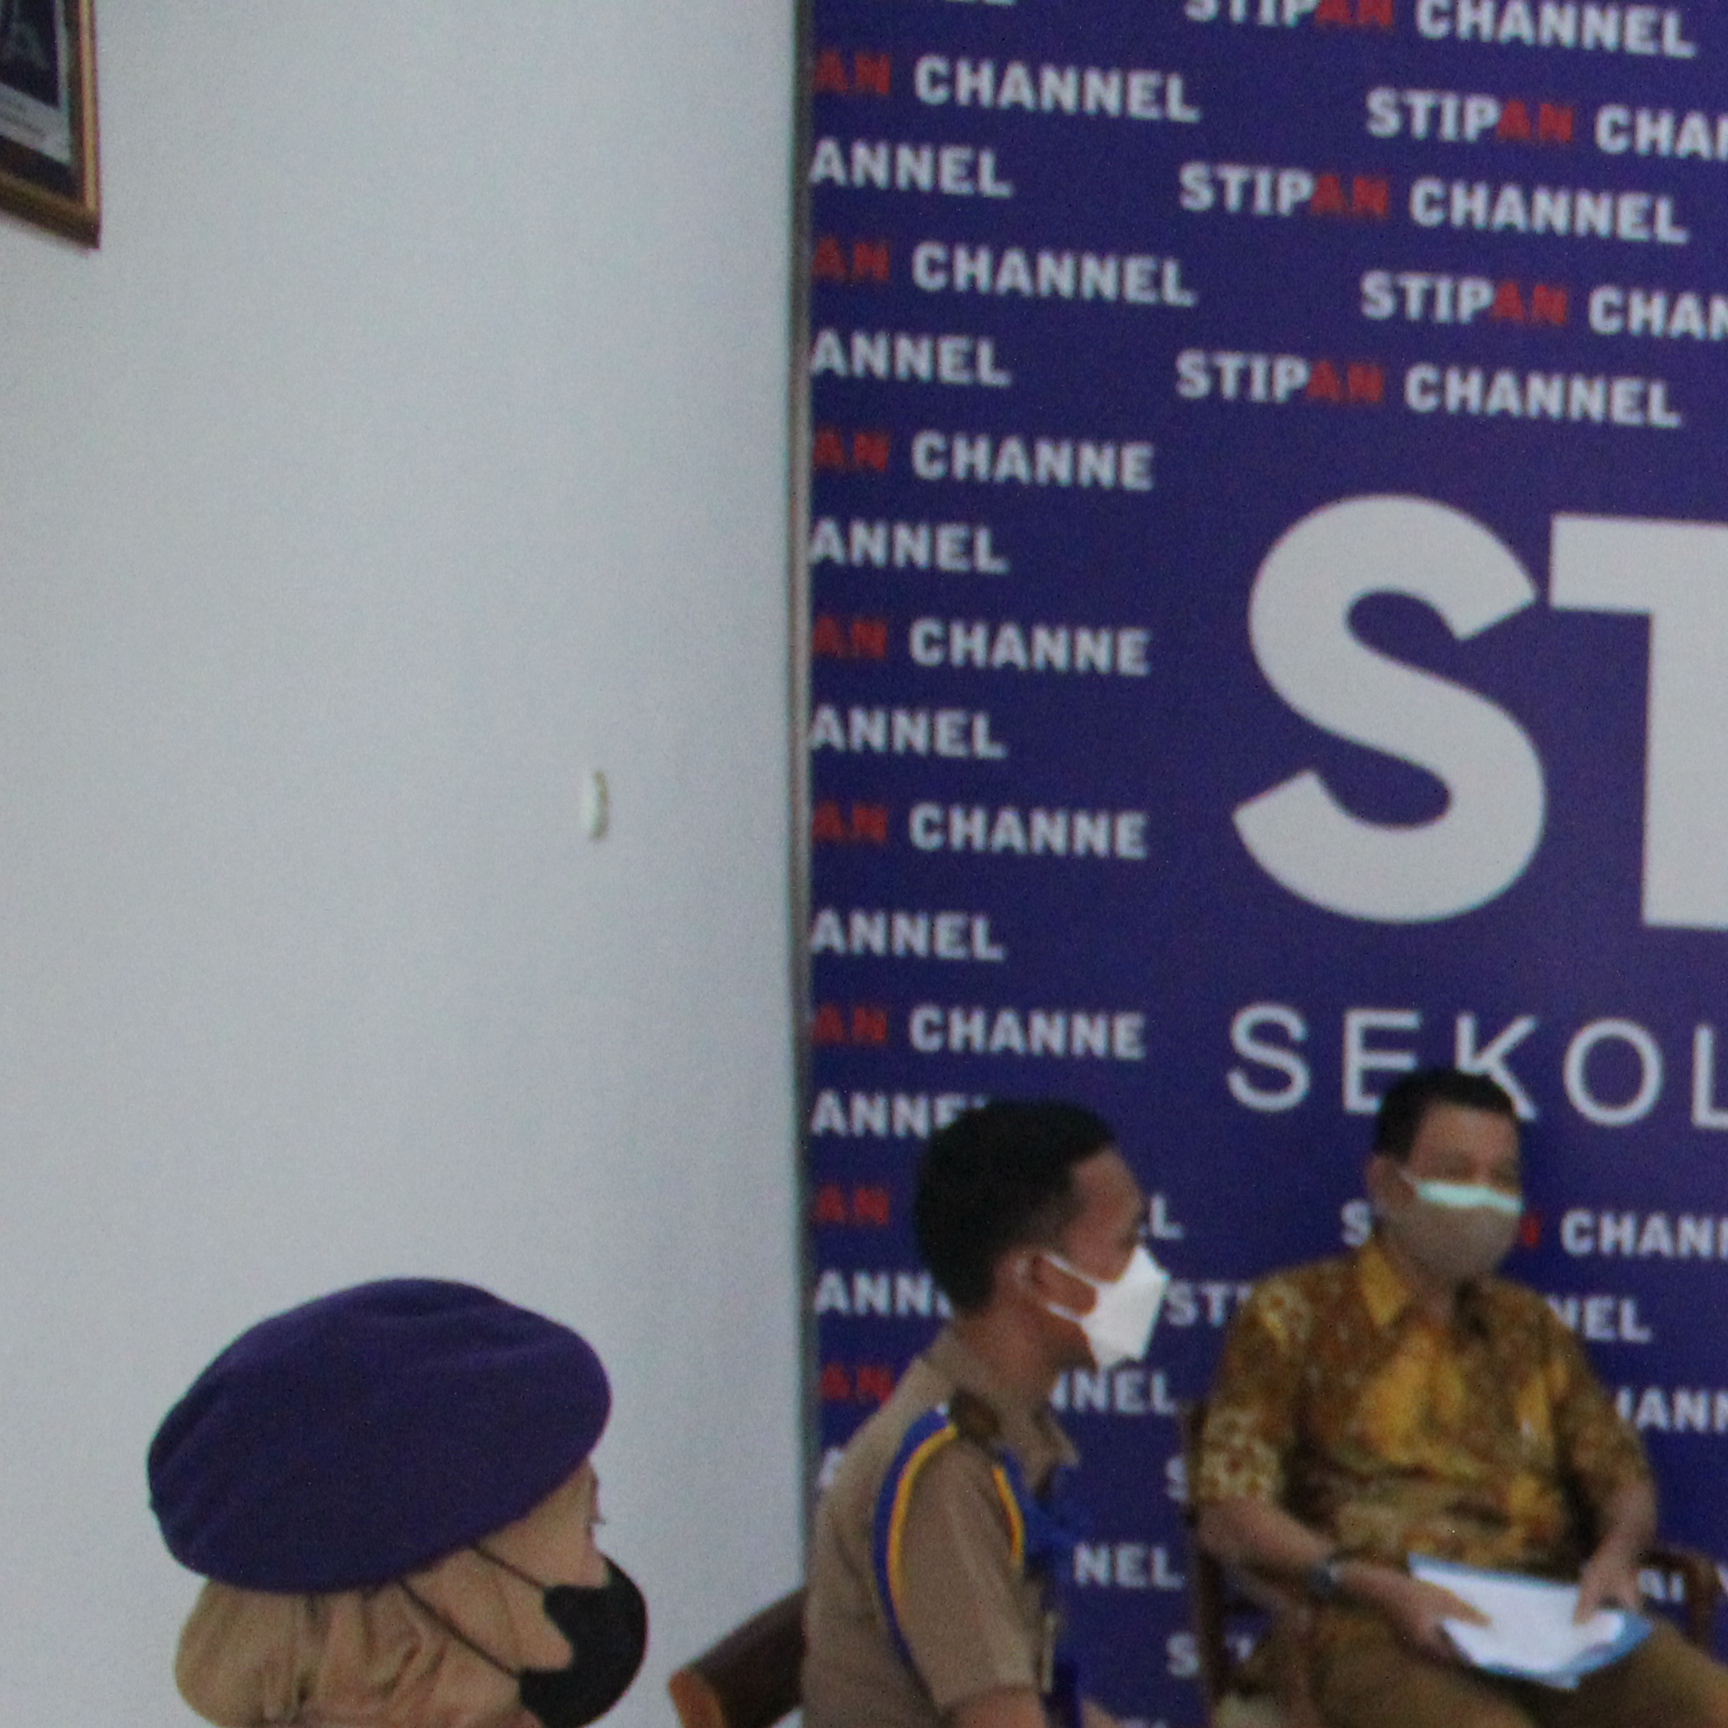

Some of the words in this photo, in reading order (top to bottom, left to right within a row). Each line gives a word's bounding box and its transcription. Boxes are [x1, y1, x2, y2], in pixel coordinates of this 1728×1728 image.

[1415, 0, 1695, 58] CHANNEL
[913, 53, 1199, 123] CHANNEL
[1366, 86, 1574, 142] STIPAN
[1179, 161, 1389, 216] STIPAN
[1408, 176, 1688, 245] CHANNEL
[911, 240, 1195, 307] CHANNEL
[1360, 269, 1568, 324] STIPAN
[1175, 349, 1384, 403] STIPAN
[1404, 363, 1681, 428] CHANNEL
